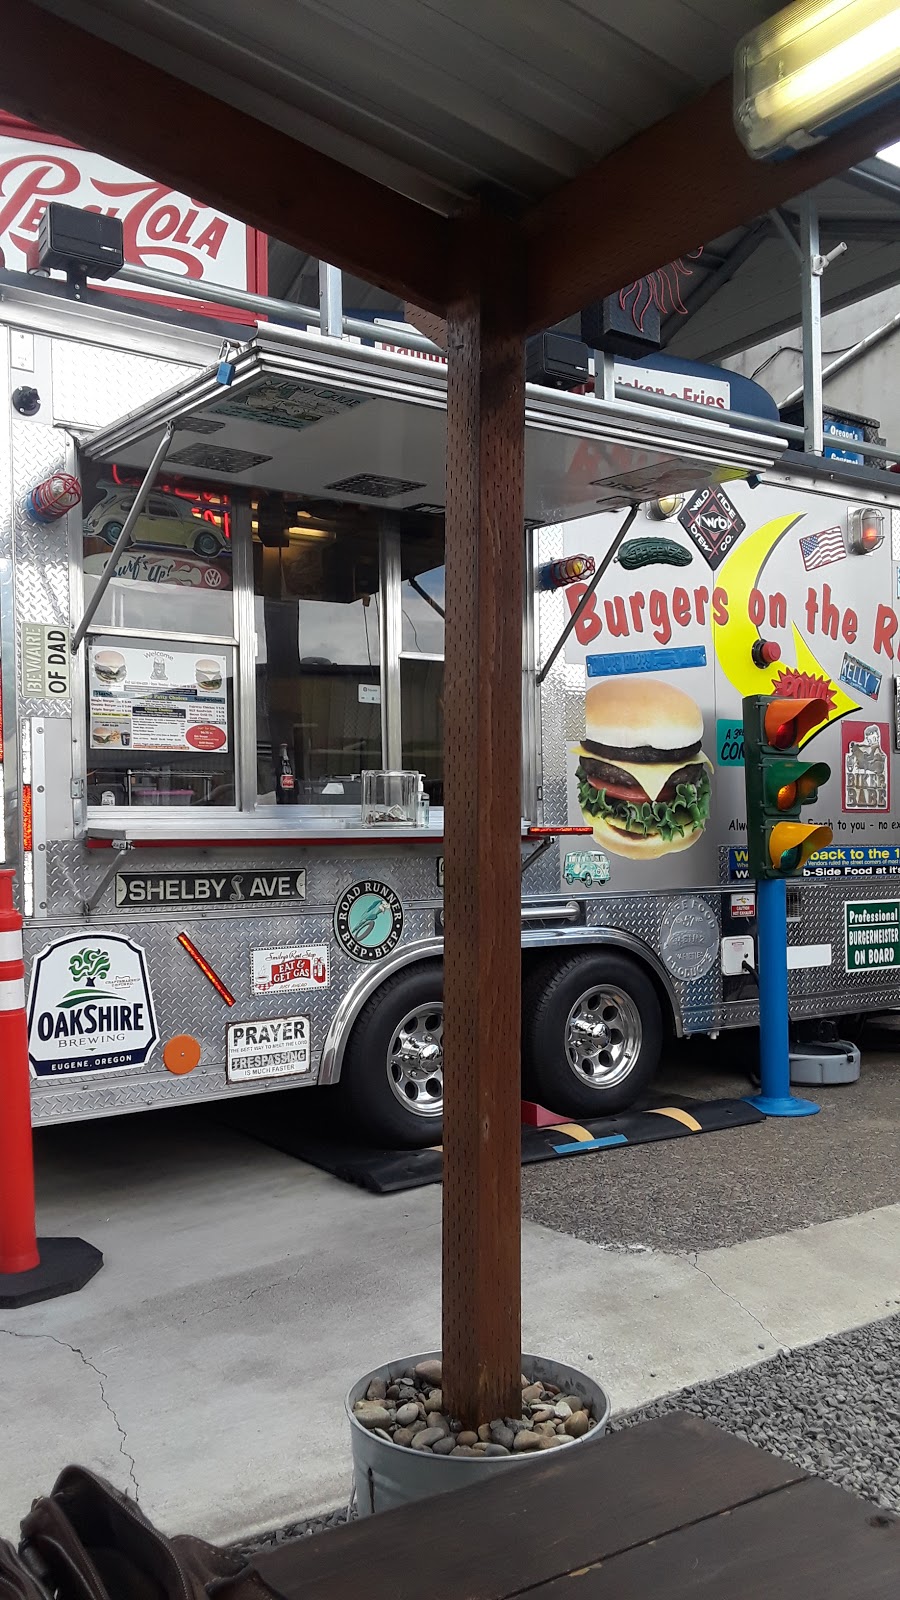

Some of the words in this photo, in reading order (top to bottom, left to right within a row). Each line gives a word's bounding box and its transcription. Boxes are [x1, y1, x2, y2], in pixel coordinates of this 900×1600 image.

[689, 489, 710, 512] WILD
[147, 564, 173, 583] Up!
[565, 583, 730, 646] Burgers
[748, 588, 787, 628] on
[805, 583, 858, 645] the
[873, 603, 900, 664] R
[47, 630, 67, 667] DAD
[143, 651, 174, 662] Welcome
[26, 626, 42, 693] BEWARE
[47, 670, 67, 694] OF
[842, 659, 871, 688] KELLY
[875, 677, 881, 694] 7
[725, 728, 731, 740] A
[847, 773, 886, 788] BIKER
[847, 788, 886, 807] BABE
[728, 819, 748, 831] Alw
[837, 819, 847, 830] to
[850, 821, 866, 834] you
[878, 821, 888, 830] no
[891, 821, 900, 830] ex
[810, 848, 846, 861] back
[850, 849, 864, 860] to
[868, 848, 890, 859] the
[803, 867, 841, 876] b-Side
[845, 866, 873, 875] Food
[876, 866, 887, 874] at
[129, 877, 227, 901] SHELBY
[249, 876, 296, 897] AVE.
[339, 886, 361, 921] ROAD
[364, 882, 402, 921] RUNNER
[691, 898, 716, 929] FOOD
[849, 907, 898, 924] Professional
[341, 931, 367, 958] BEEP
[374, 930, 399, 958] BEEP
[848, 927, 899, 946] BURGERMEISTER
[279, 961, 295, 973] EAT
[296, 959, 305, 968] &
[854, 949, 866, 966] ON
[868, 947, 894, 964] BOARD
[273, 972, 291, 983] GET
[293, 968, 310, 978] GAS
[37, 1003, 144, 1042] OAKSHIRE
[58, 1033, 125, 1048] BREWING
[233, 1021, 306, 1047] PRAYER
[94, 1054, 132, 1066] OREGON
[231, 1050, 306, 1070] TRESPASSING
[252, 1067, 271, 1075] MUCH
[271, 1064, 295, 1073] FASTER
